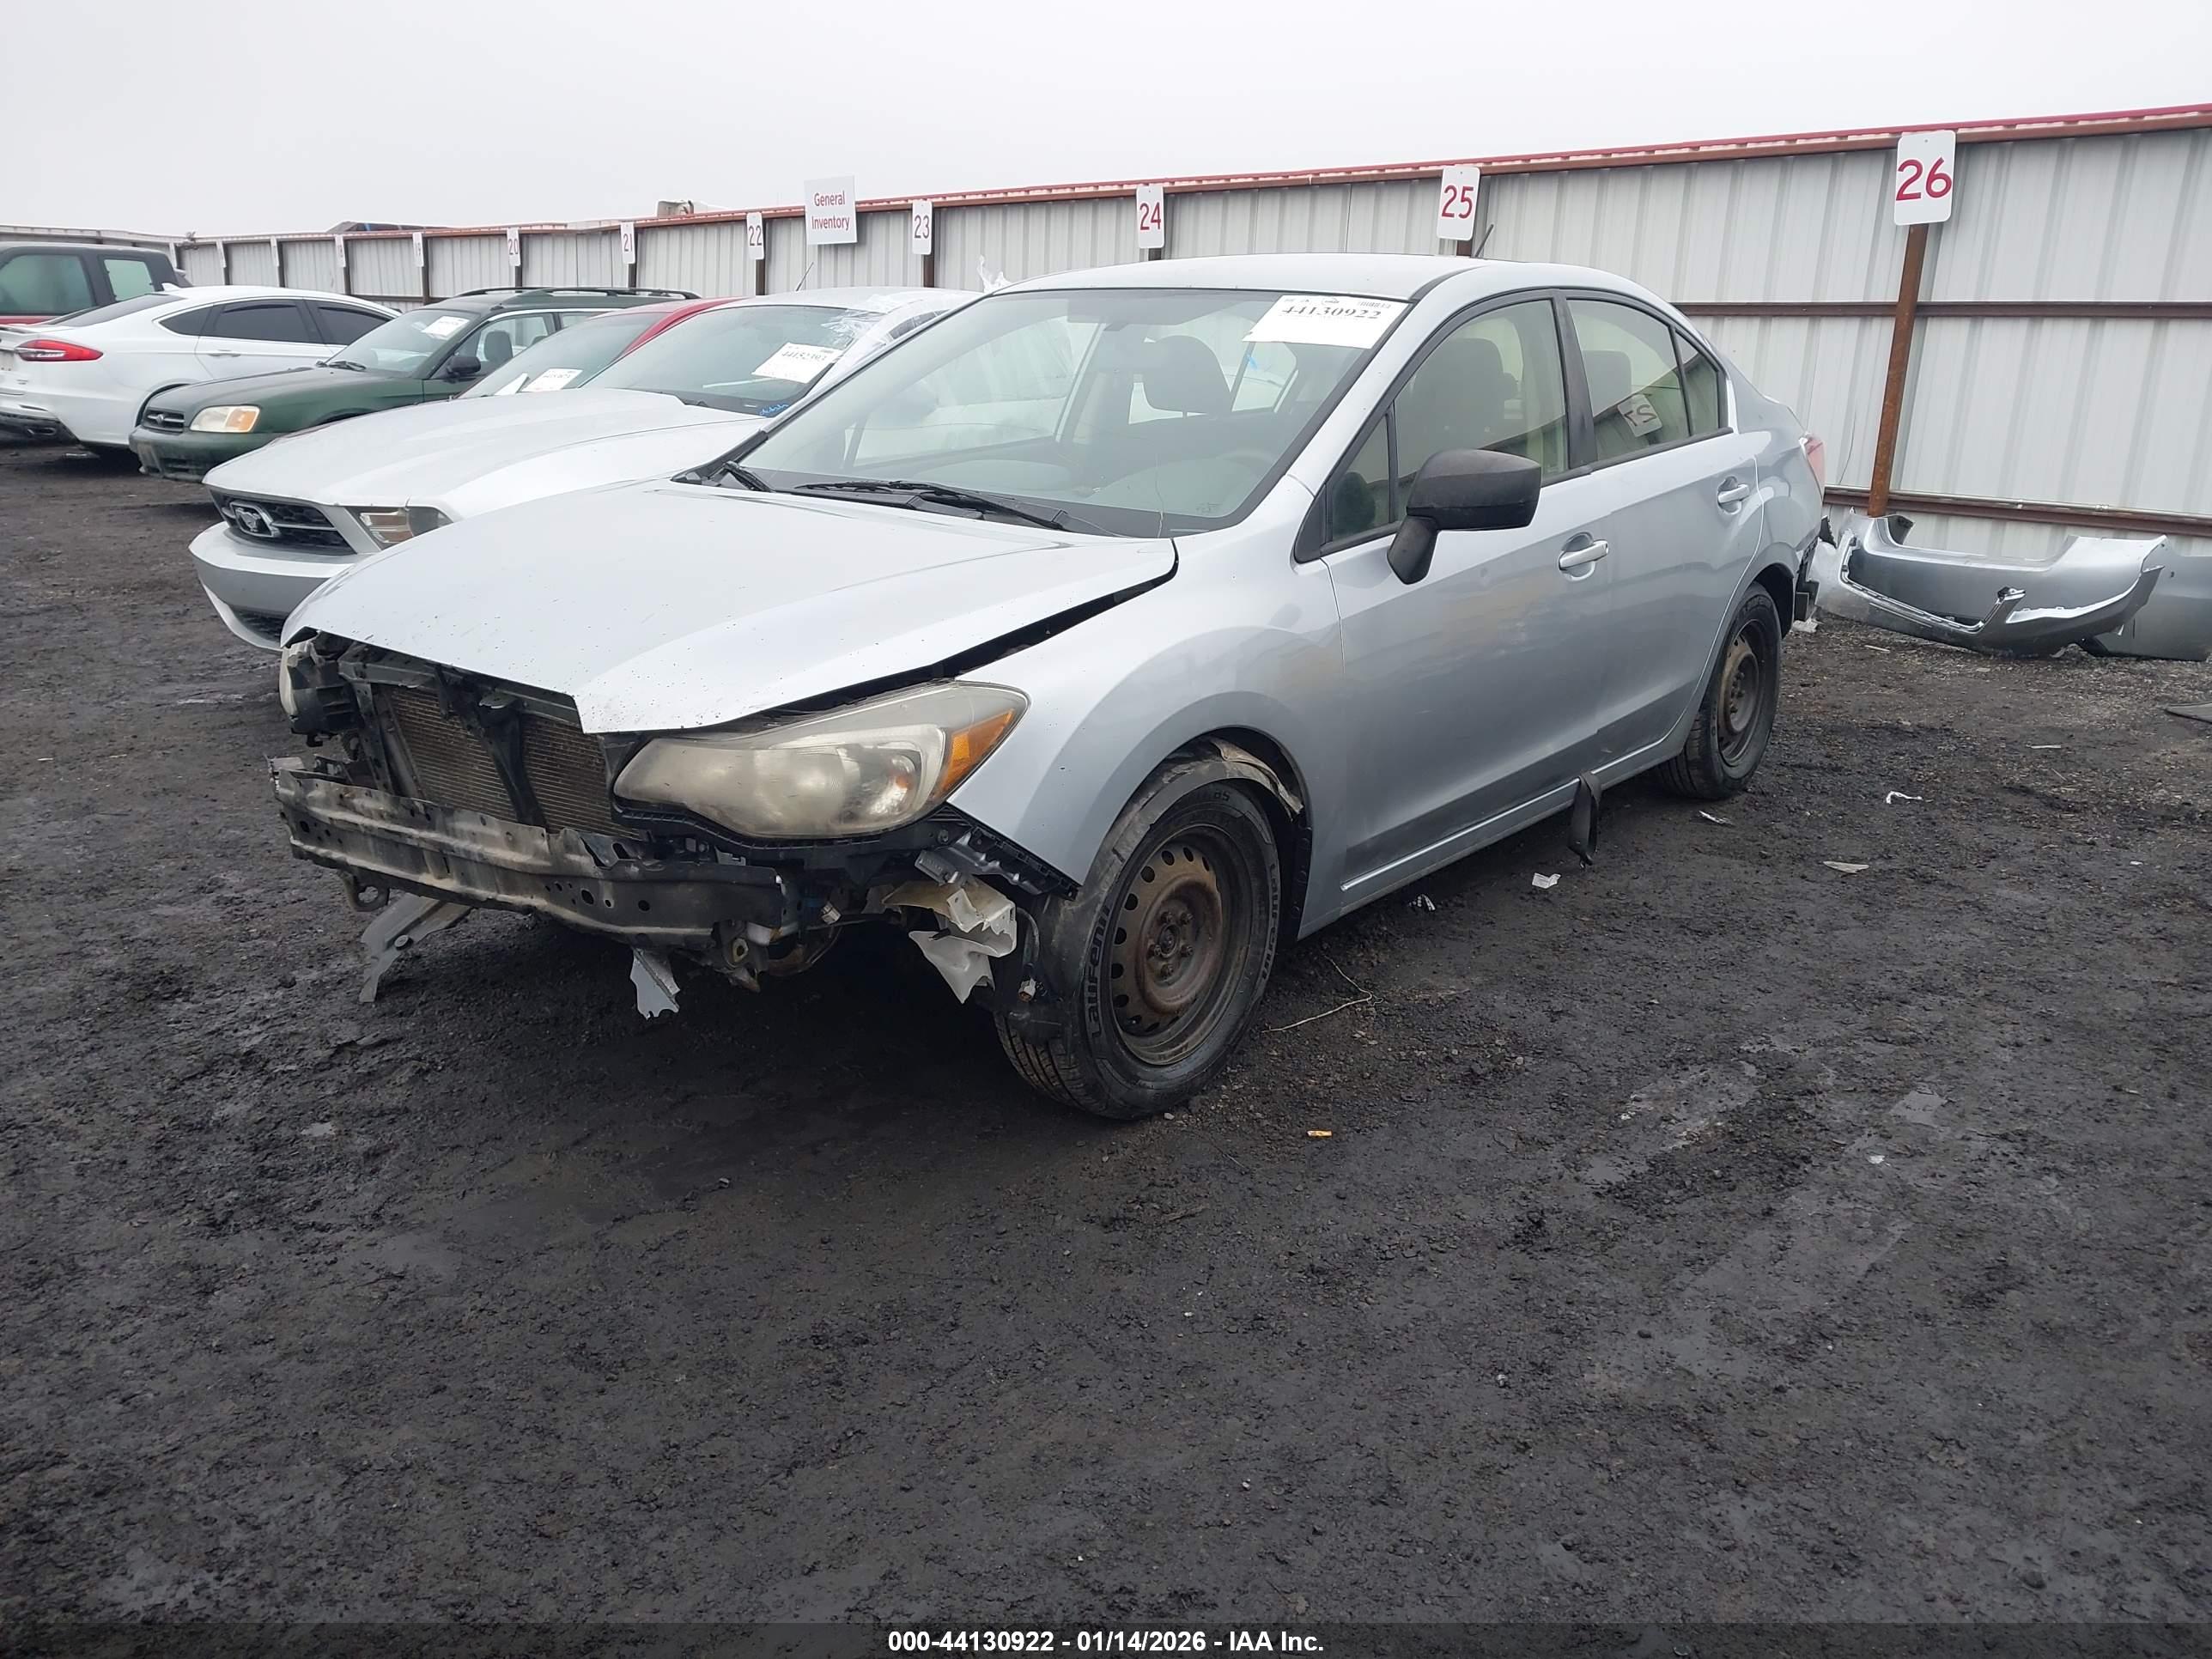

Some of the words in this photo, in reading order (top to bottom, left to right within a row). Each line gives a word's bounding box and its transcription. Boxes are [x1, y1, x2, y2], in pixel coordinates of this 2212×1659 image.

[1895, 156, 1953, 201] 26
[813, 191, 846, 207] General
[1441, 185, 1474, 219] 25
[811, 216, 850, 231] Inventory
[1139, 202, 1162, 231] 24
[748, 225, 763, 246] 22
[914, 215, 930, 239] 23
[507, 238, 519, 256] 20
[623, 233, 633, 252] 21
[1281, 305, 1382, 319] 44130922
